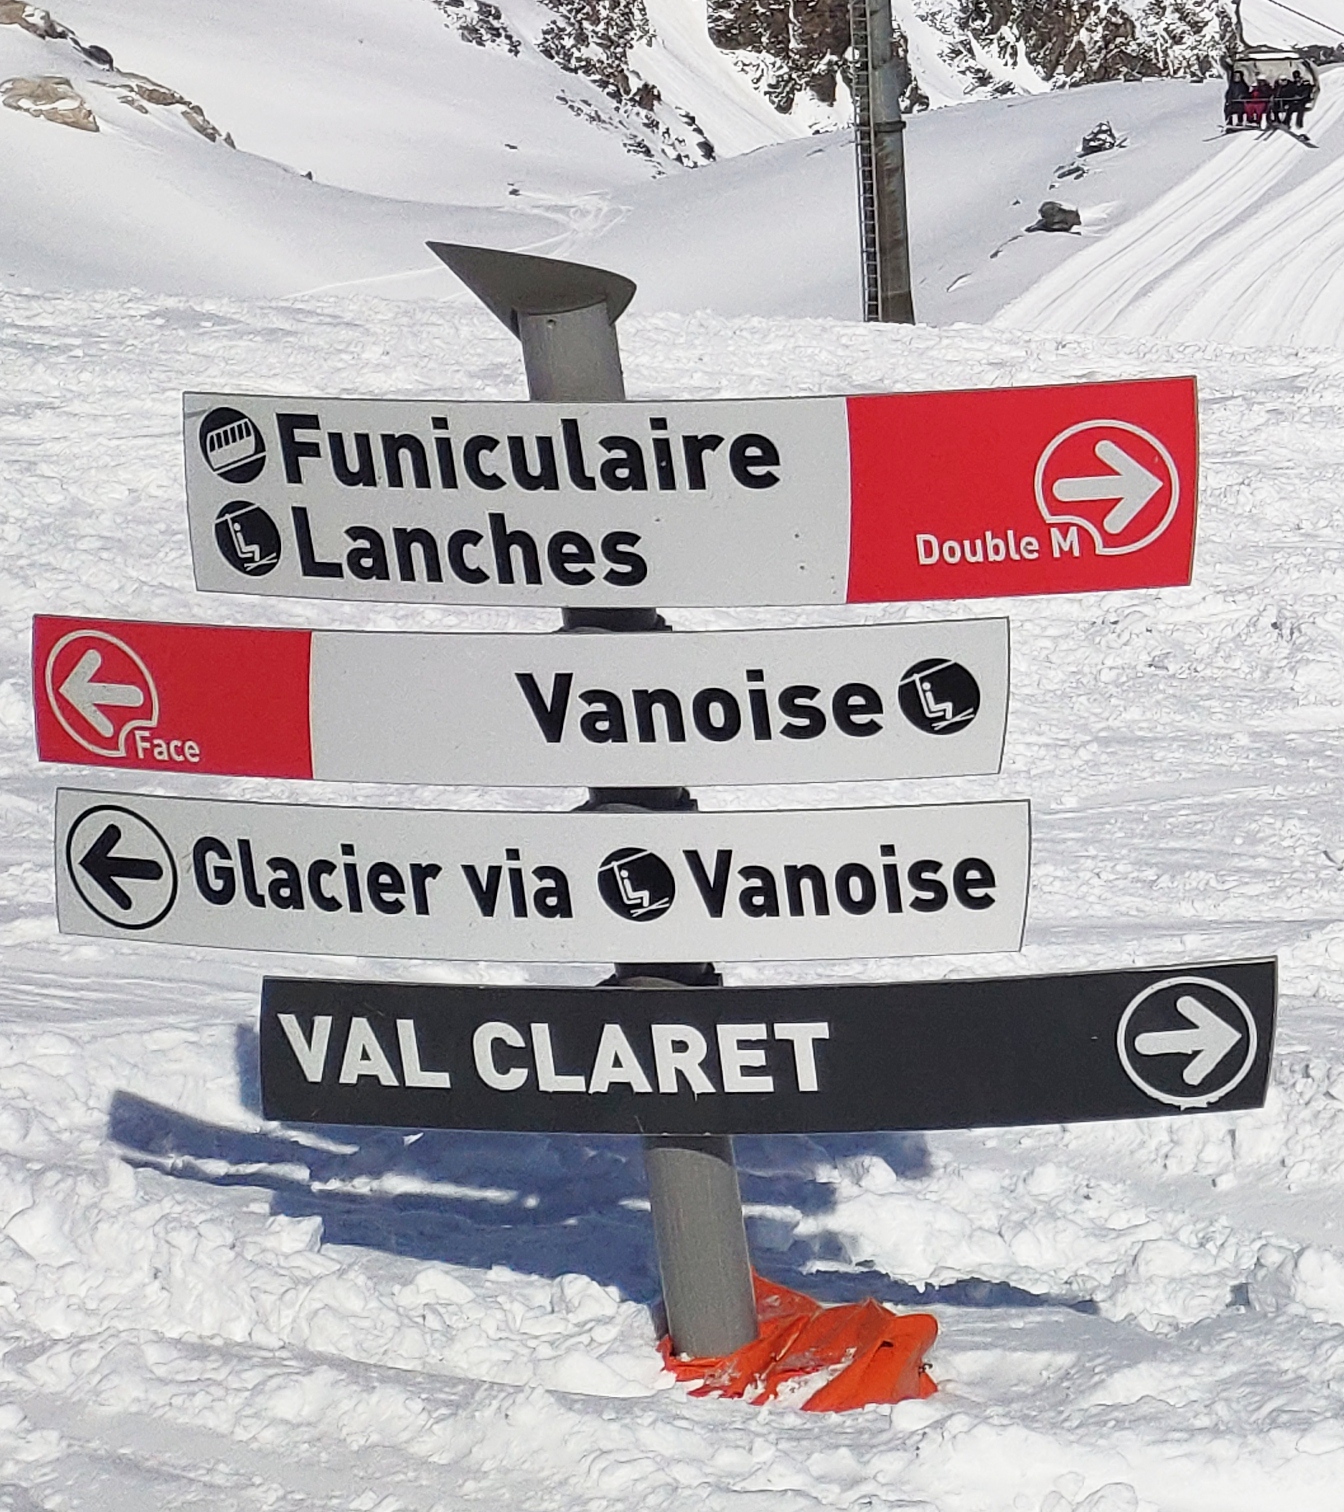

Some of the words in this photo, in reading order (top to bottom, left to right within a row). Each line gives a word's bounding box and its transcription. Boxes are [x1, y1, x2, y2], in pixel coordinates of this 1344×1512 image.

[275, 413, 781, 491] Funiculaire
[290, 505, 648, 587] Lanches
[915, 529, 1040, 565] Double
[1050, 526, 1081, 558] M
[514, 669, 884, 744] Vanoise
[134, 730, 201, 763] Face
[192, 836, 443, 916] Glacier
[460, 848, 574, 919] via
[684, 843, 998, 918] Vanoise
[277, 1013, 451, 1089] VAL
[472, 1021, 830, 1096] CLARET
